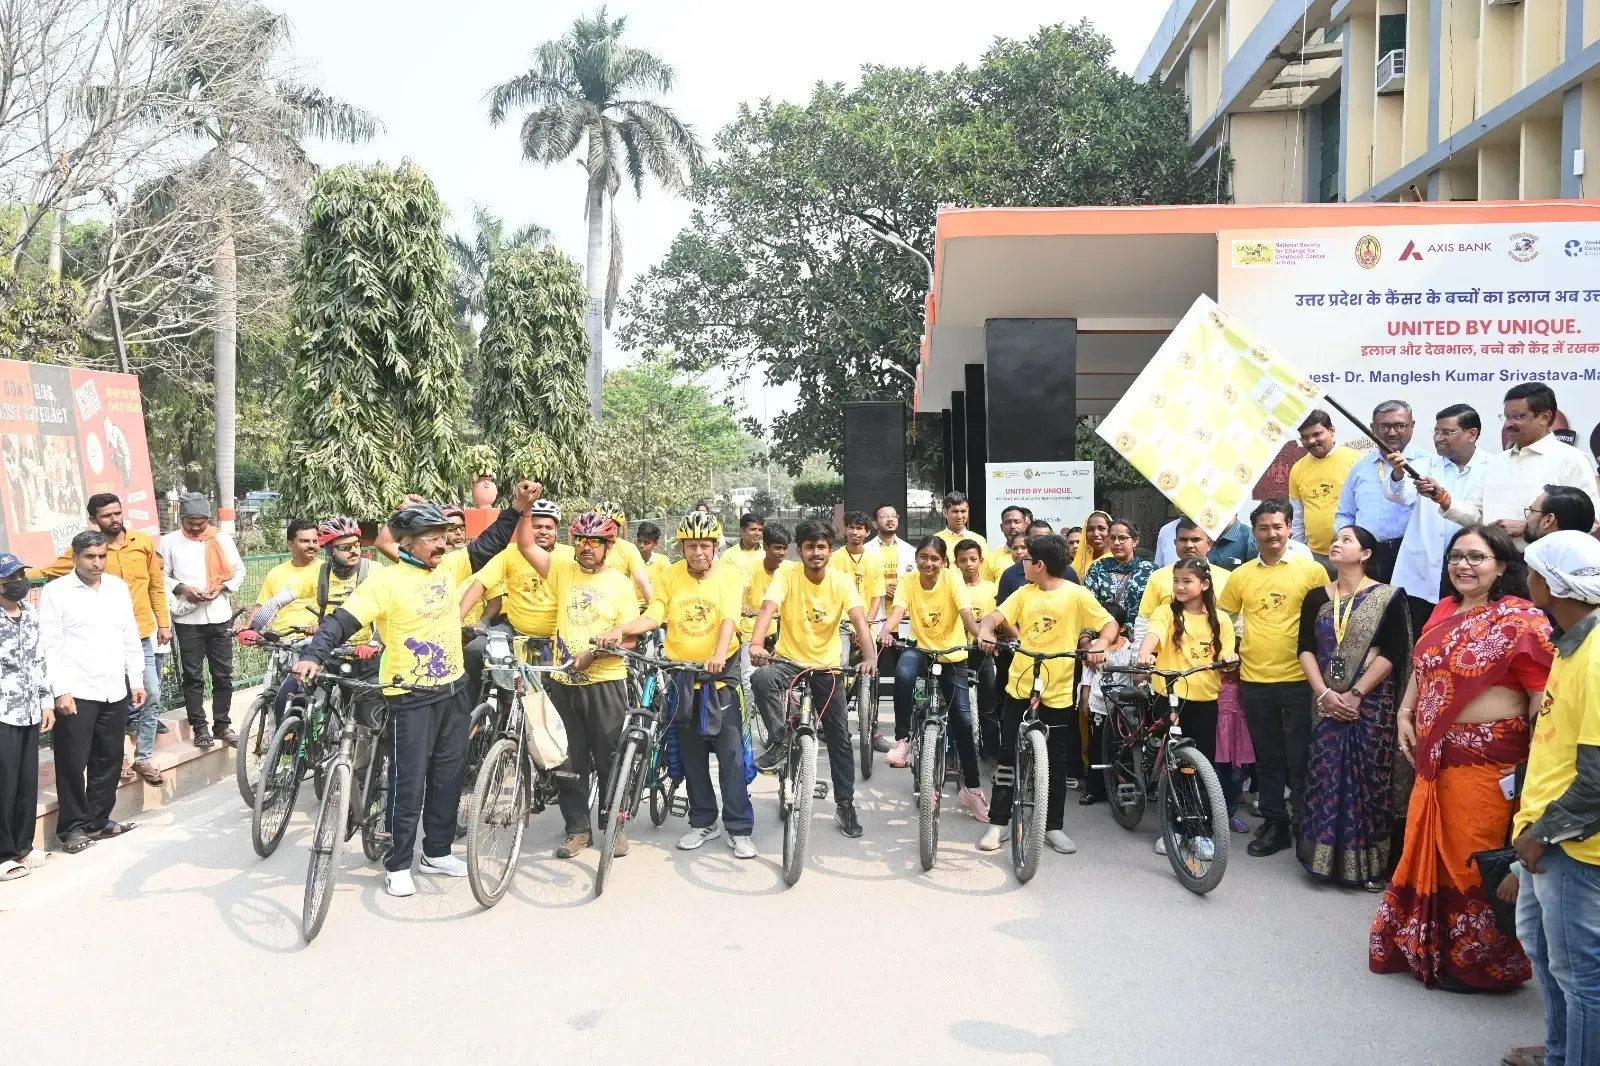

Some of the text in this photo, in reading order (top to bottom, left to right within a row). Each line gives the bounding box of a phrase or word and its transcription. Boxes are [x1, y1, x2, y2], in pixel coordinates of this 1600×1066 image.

[1285, 247, 1305, 255] Change
[1427, 242, 1492, 253] AXIS BANK
[1295, 294, 1325, 306] उत्तर
[1328, 290, 1362, 306] प्रदेश
[1366, 290, 1382, 305] के
[1385, 288, 1422, 305] कैंसर
[1426, 288, 1442, 304] के
[1445, 288, 1480, 304] बच्चों
[1483, 291, 1503, 303] का
[1507, 291, 1551, 304] इलाज
[1555, 290, 1579, 303] अब
[1387, 318, 1582, 336] UNITED BY UNIQUE.
[1360, 345, 1397, 357] इलाज
[1400, 341, 1421, 356] और
[1424, 342, 1477, 356] देखभाल,
[1480, 341, 1504, 355] बच्चे
[1507, 341, 1525, 355] को
[1528, 341, 1549, 355] केंद्र
[1552, 340, 1566, 354] में
[1309, 371, 1340, 383] est-
[1344, 371, 1365, 383] Dr.
[1369, 370, 1441, 386] Manglesh
[1445, 369, 1495, 382] Kumar
